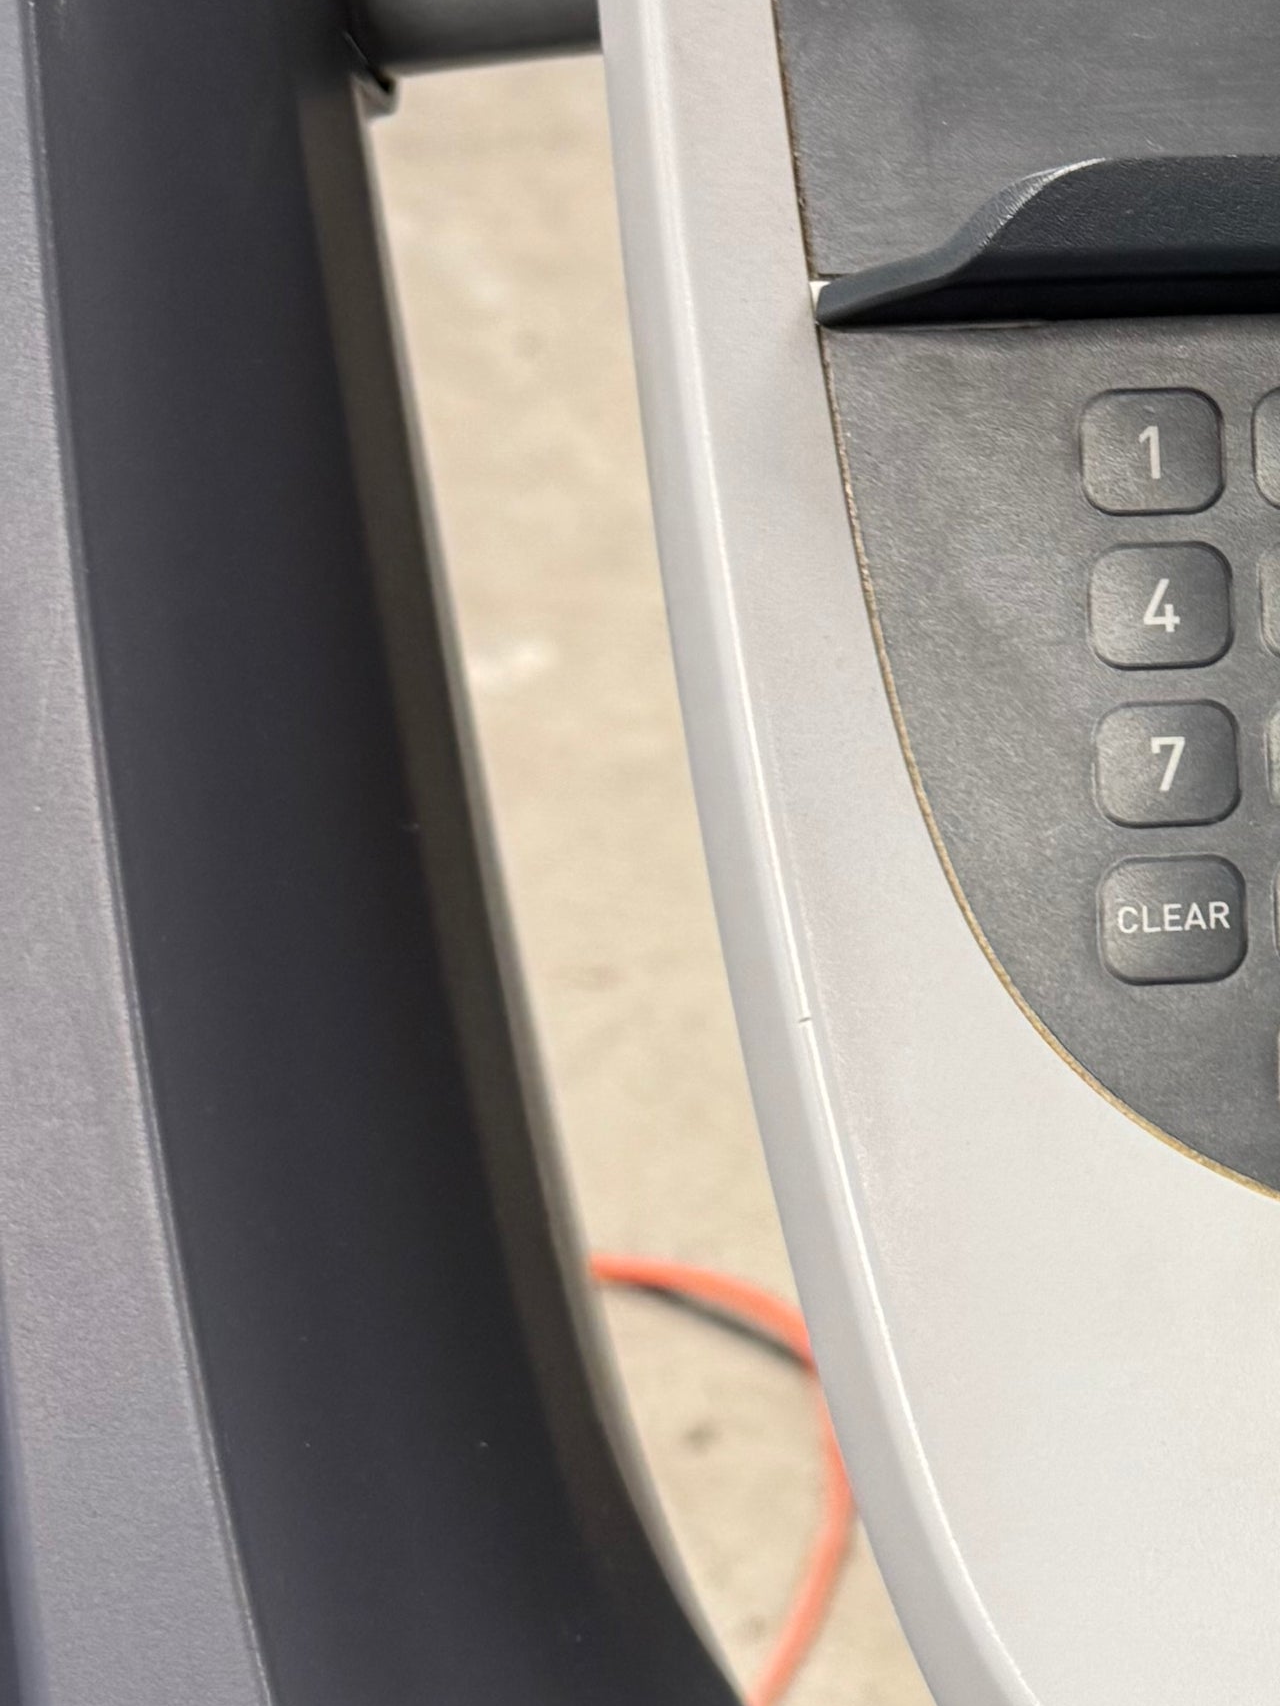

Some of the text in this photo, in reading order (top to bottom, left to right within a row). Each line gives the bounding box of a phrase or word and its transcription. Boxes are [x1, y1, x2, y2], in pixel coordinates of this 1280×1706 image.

[1138, 425, 1161, 480] 1
[1142, 578, 1181, 633] 4
[1150, 736, 1186, 792] 7
[1116, 902, 1231, 934] CLEAR
